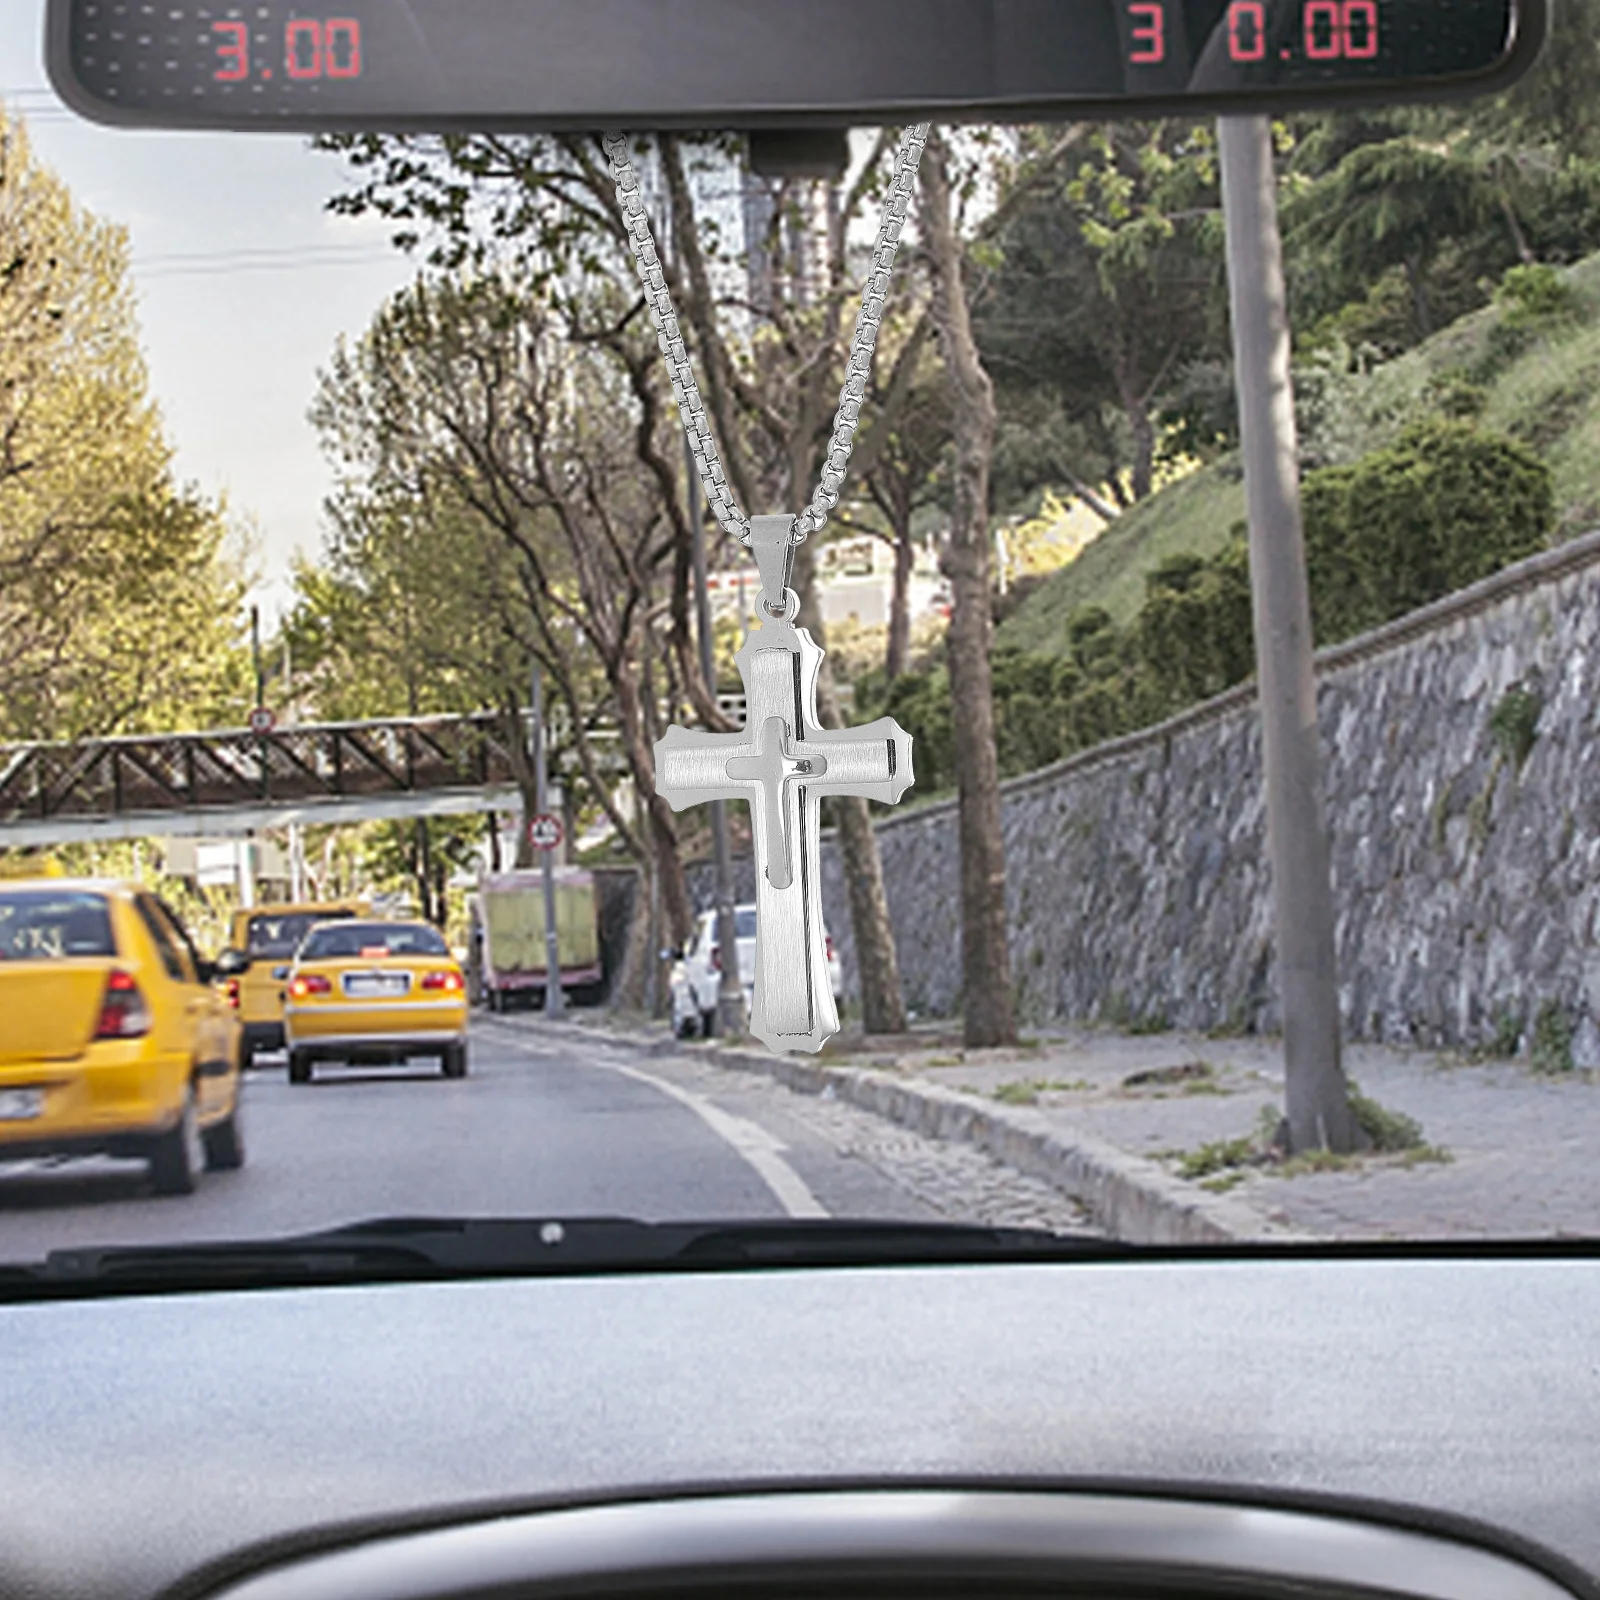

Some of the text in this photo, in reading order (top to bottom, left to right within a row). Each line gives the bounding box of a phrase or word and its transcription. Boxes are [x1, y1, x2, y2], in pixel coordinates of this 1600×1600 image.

[213, 19, 361, 80] 3.00
[1129, 0, 1378, 63] 3 0.00
